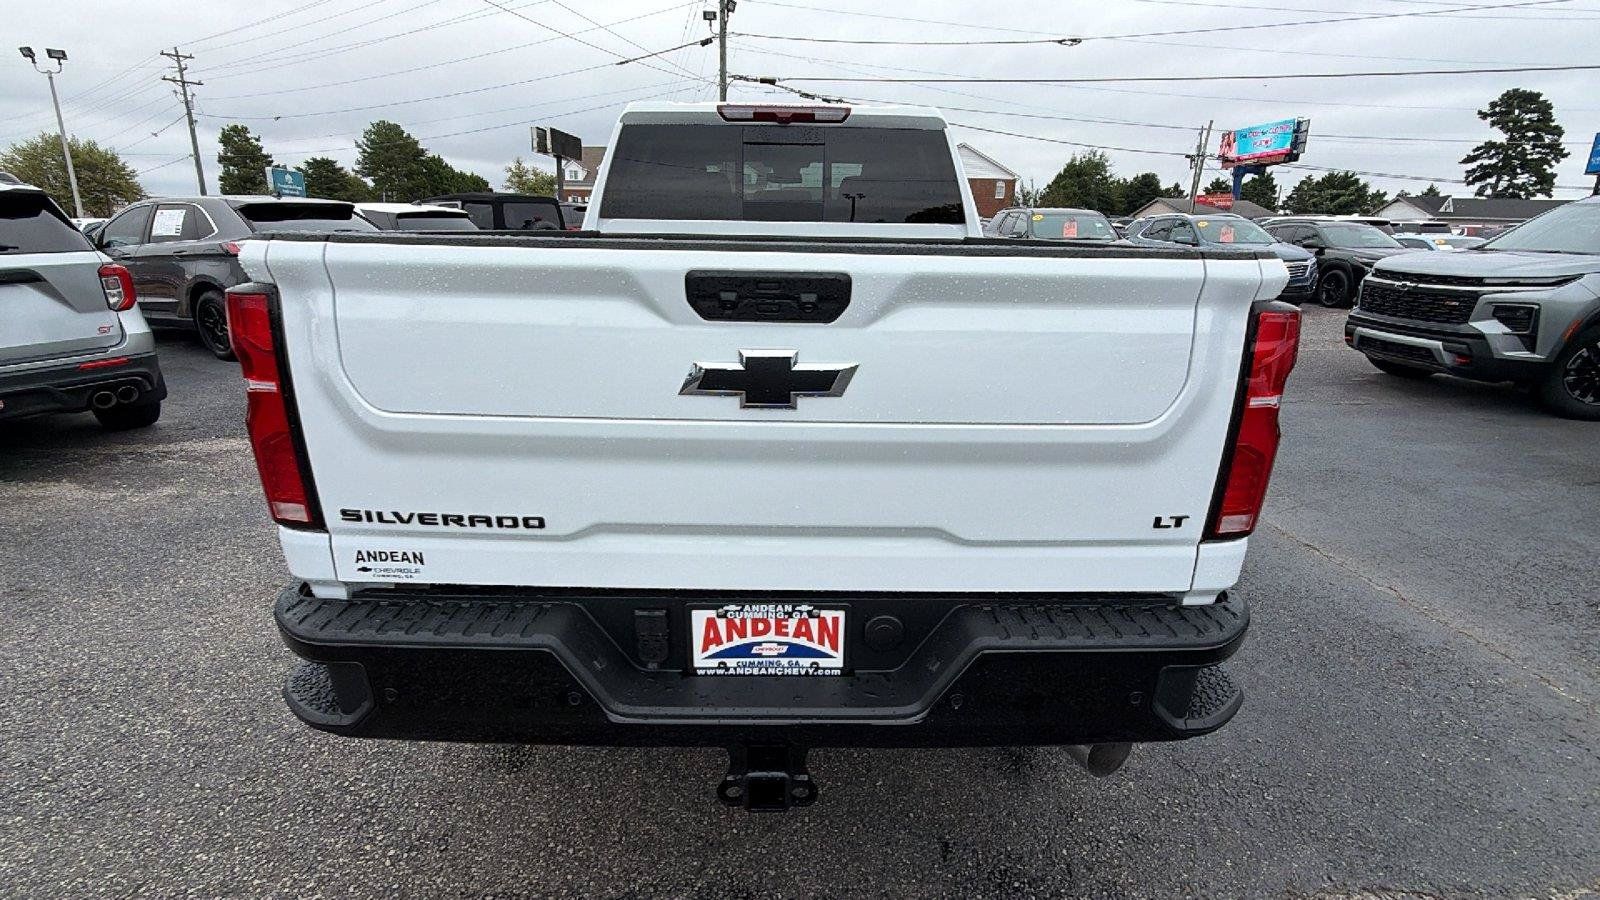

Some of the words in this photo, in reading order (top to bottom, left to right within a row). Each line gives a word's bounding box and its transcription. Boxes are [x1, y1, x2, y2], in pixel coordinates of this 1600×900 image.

[339, 508, 546, 530] SILVERADO
[1152, 515, 1191, 529] LT
[355, 550, 425, 565] ANDEAN
[743, 604, 792, 613] ANDEAN
[792, 611, 809, 619] GA
[701, 616, 839, 654] ANDEAN
[696, 667, 841, 676] www.ANDEANCHEVY.com
